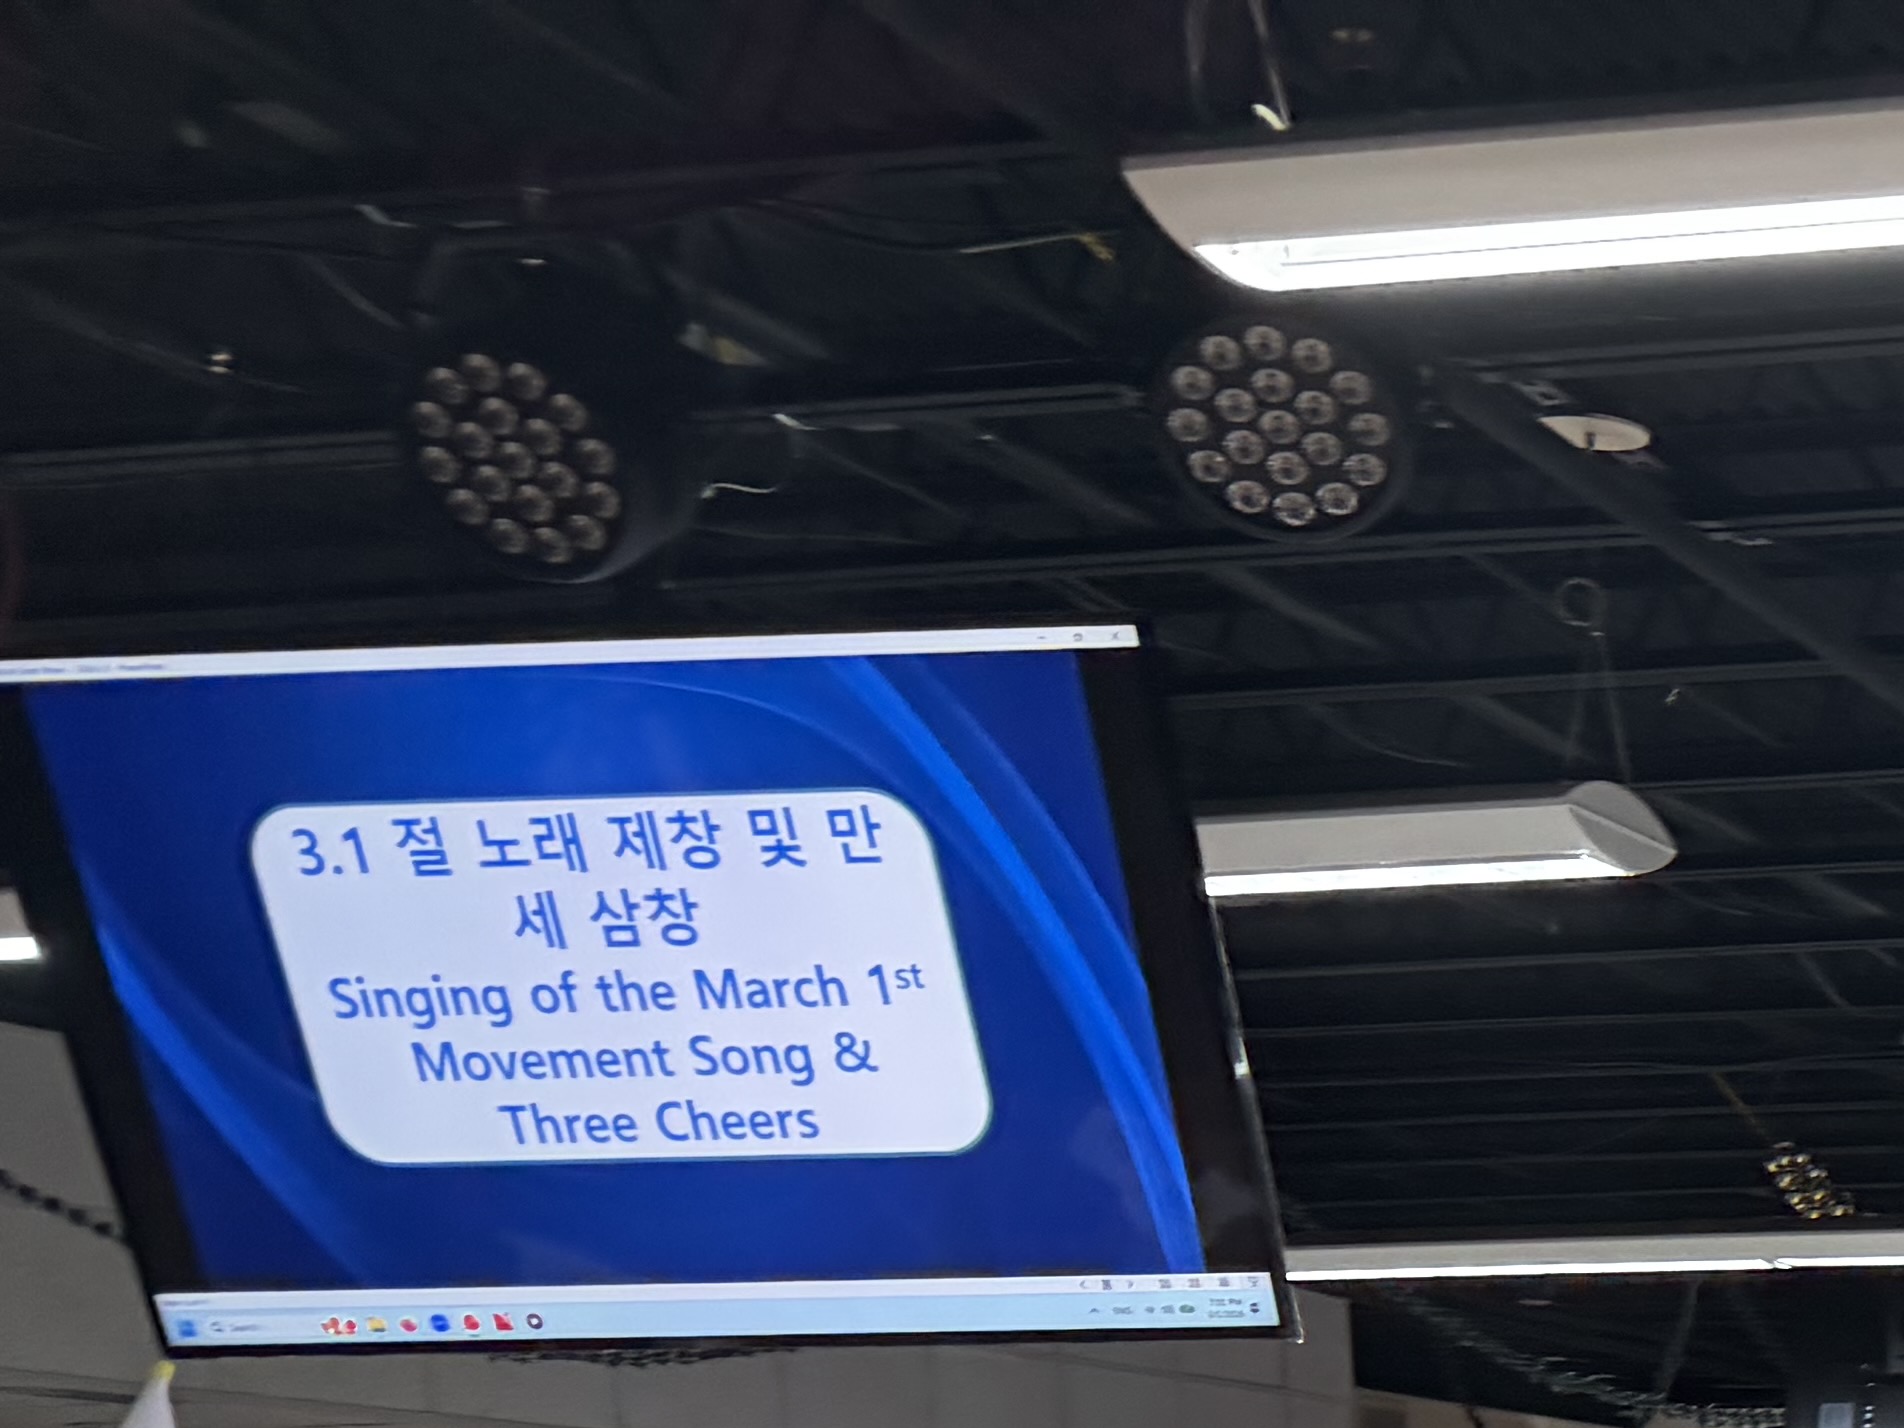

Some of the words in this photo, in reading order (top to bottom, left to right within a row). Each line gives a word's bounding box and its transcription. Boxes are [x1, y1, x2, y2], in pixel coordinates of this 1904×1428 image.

[291, 826, 370, 877] 3.1
[390, 816, 454, 878] 절
[477, 811, 589, 873] 노래
[606, 809, 722, 871] 제창
[746, 808, 808, 869] 및
[825, 804, 883, 866] 만
[514, 890, 569, 950] 세
[589, 887, 699, 949] 삼창
[328, 973, 514, 1031] Singing
[530, 969, 578, 1015] of
[594, 969, 677, 1013] the
[692, 964, 849, 1011] March
[867, 963, 926, 1007] 1st
[410, 1040, 677, 1083] Movement
[688, 1034, 815, 1087] Song
[834, 1031, 879, 1074] &
[497, 1102, 639, 1146] Three
[655, 1100, 820, 1143] Cheers
